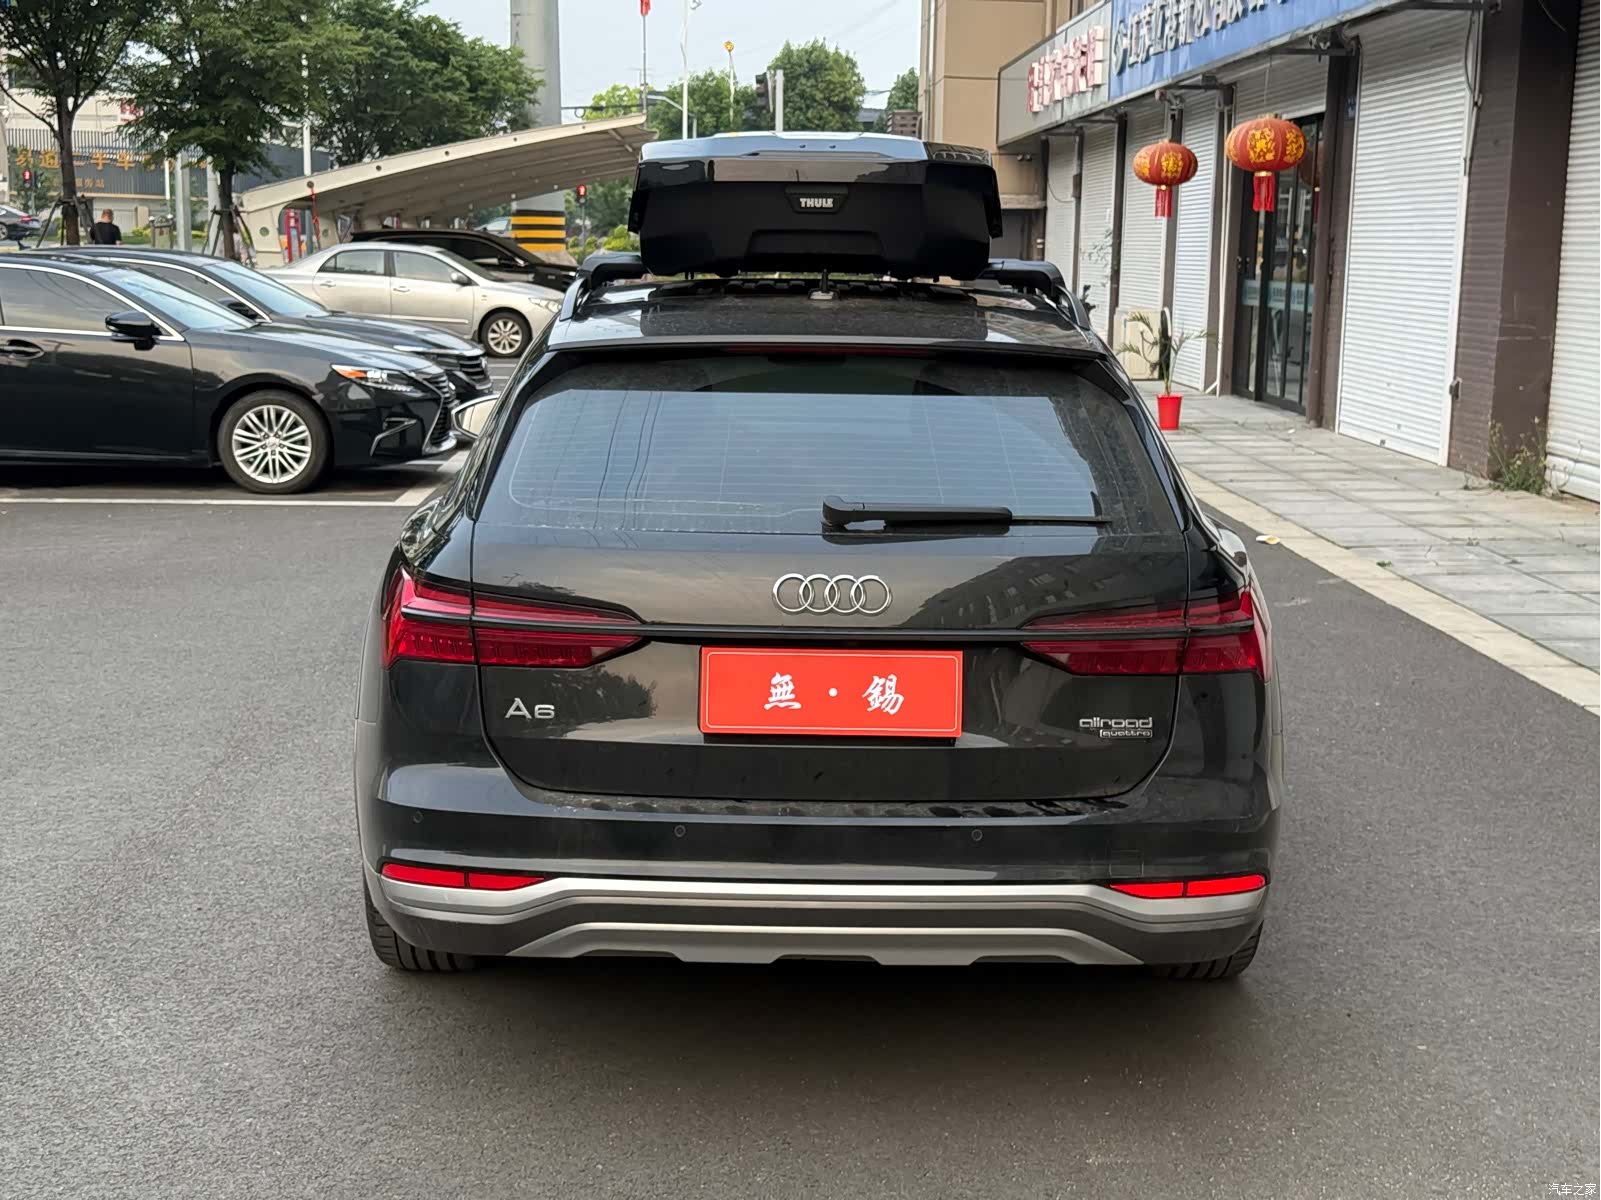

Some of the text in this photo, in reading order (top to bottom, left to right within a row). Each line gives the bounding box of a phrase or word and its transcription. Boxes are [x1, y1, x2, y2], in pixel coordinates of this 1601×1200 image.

[799, 197, 834, 208] THULE
[504, 697, 556, 719] A6
[1079, 716, 1153, 728] allroad
[1101, 729, 1152, 738] quattro
